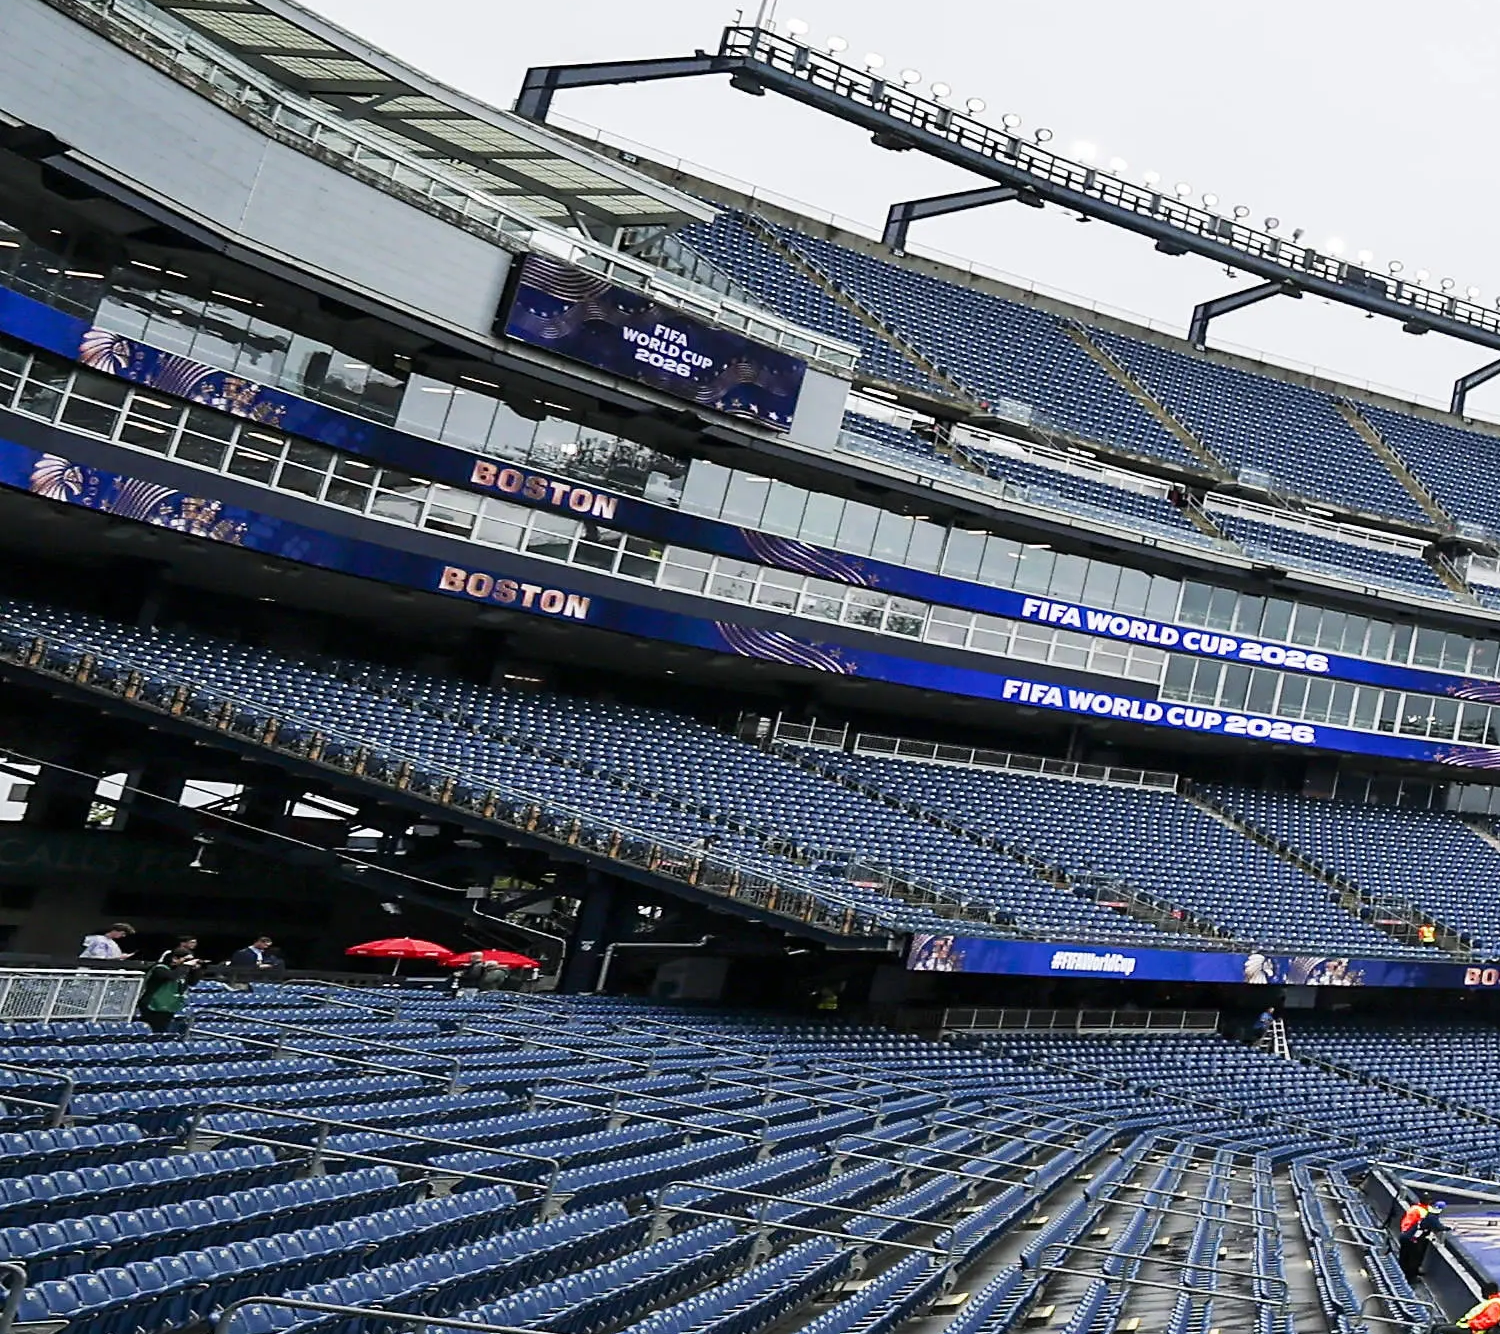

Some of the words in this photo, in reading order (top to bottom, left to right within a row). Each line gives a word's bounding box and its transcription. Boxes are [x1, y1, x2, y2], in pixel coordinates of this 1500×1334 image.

[622, 326, 681, 358] WORLD
[681, 347, 713, 369] CUP
[634, 348, 691, 377] 2026
[655, 324, 688, 347] FIFA
[471, 460, 618, 519] BOSTON
[438, 566, 590, 620] BOSTON
[1022, 598, 1081, 627] FIFA
[1085, 610, 1180, 647] WORLD
[1182, 631, 1237, 656] CUP
[1238, 642, 1329, 673] 2026
[1001, 679, 1063, 706] FIFA
[1067, 689, 1162, 722] WORLD
[1166, 707, 1223, 729] CUP
[1223, 715, 1315, 743] 2026
